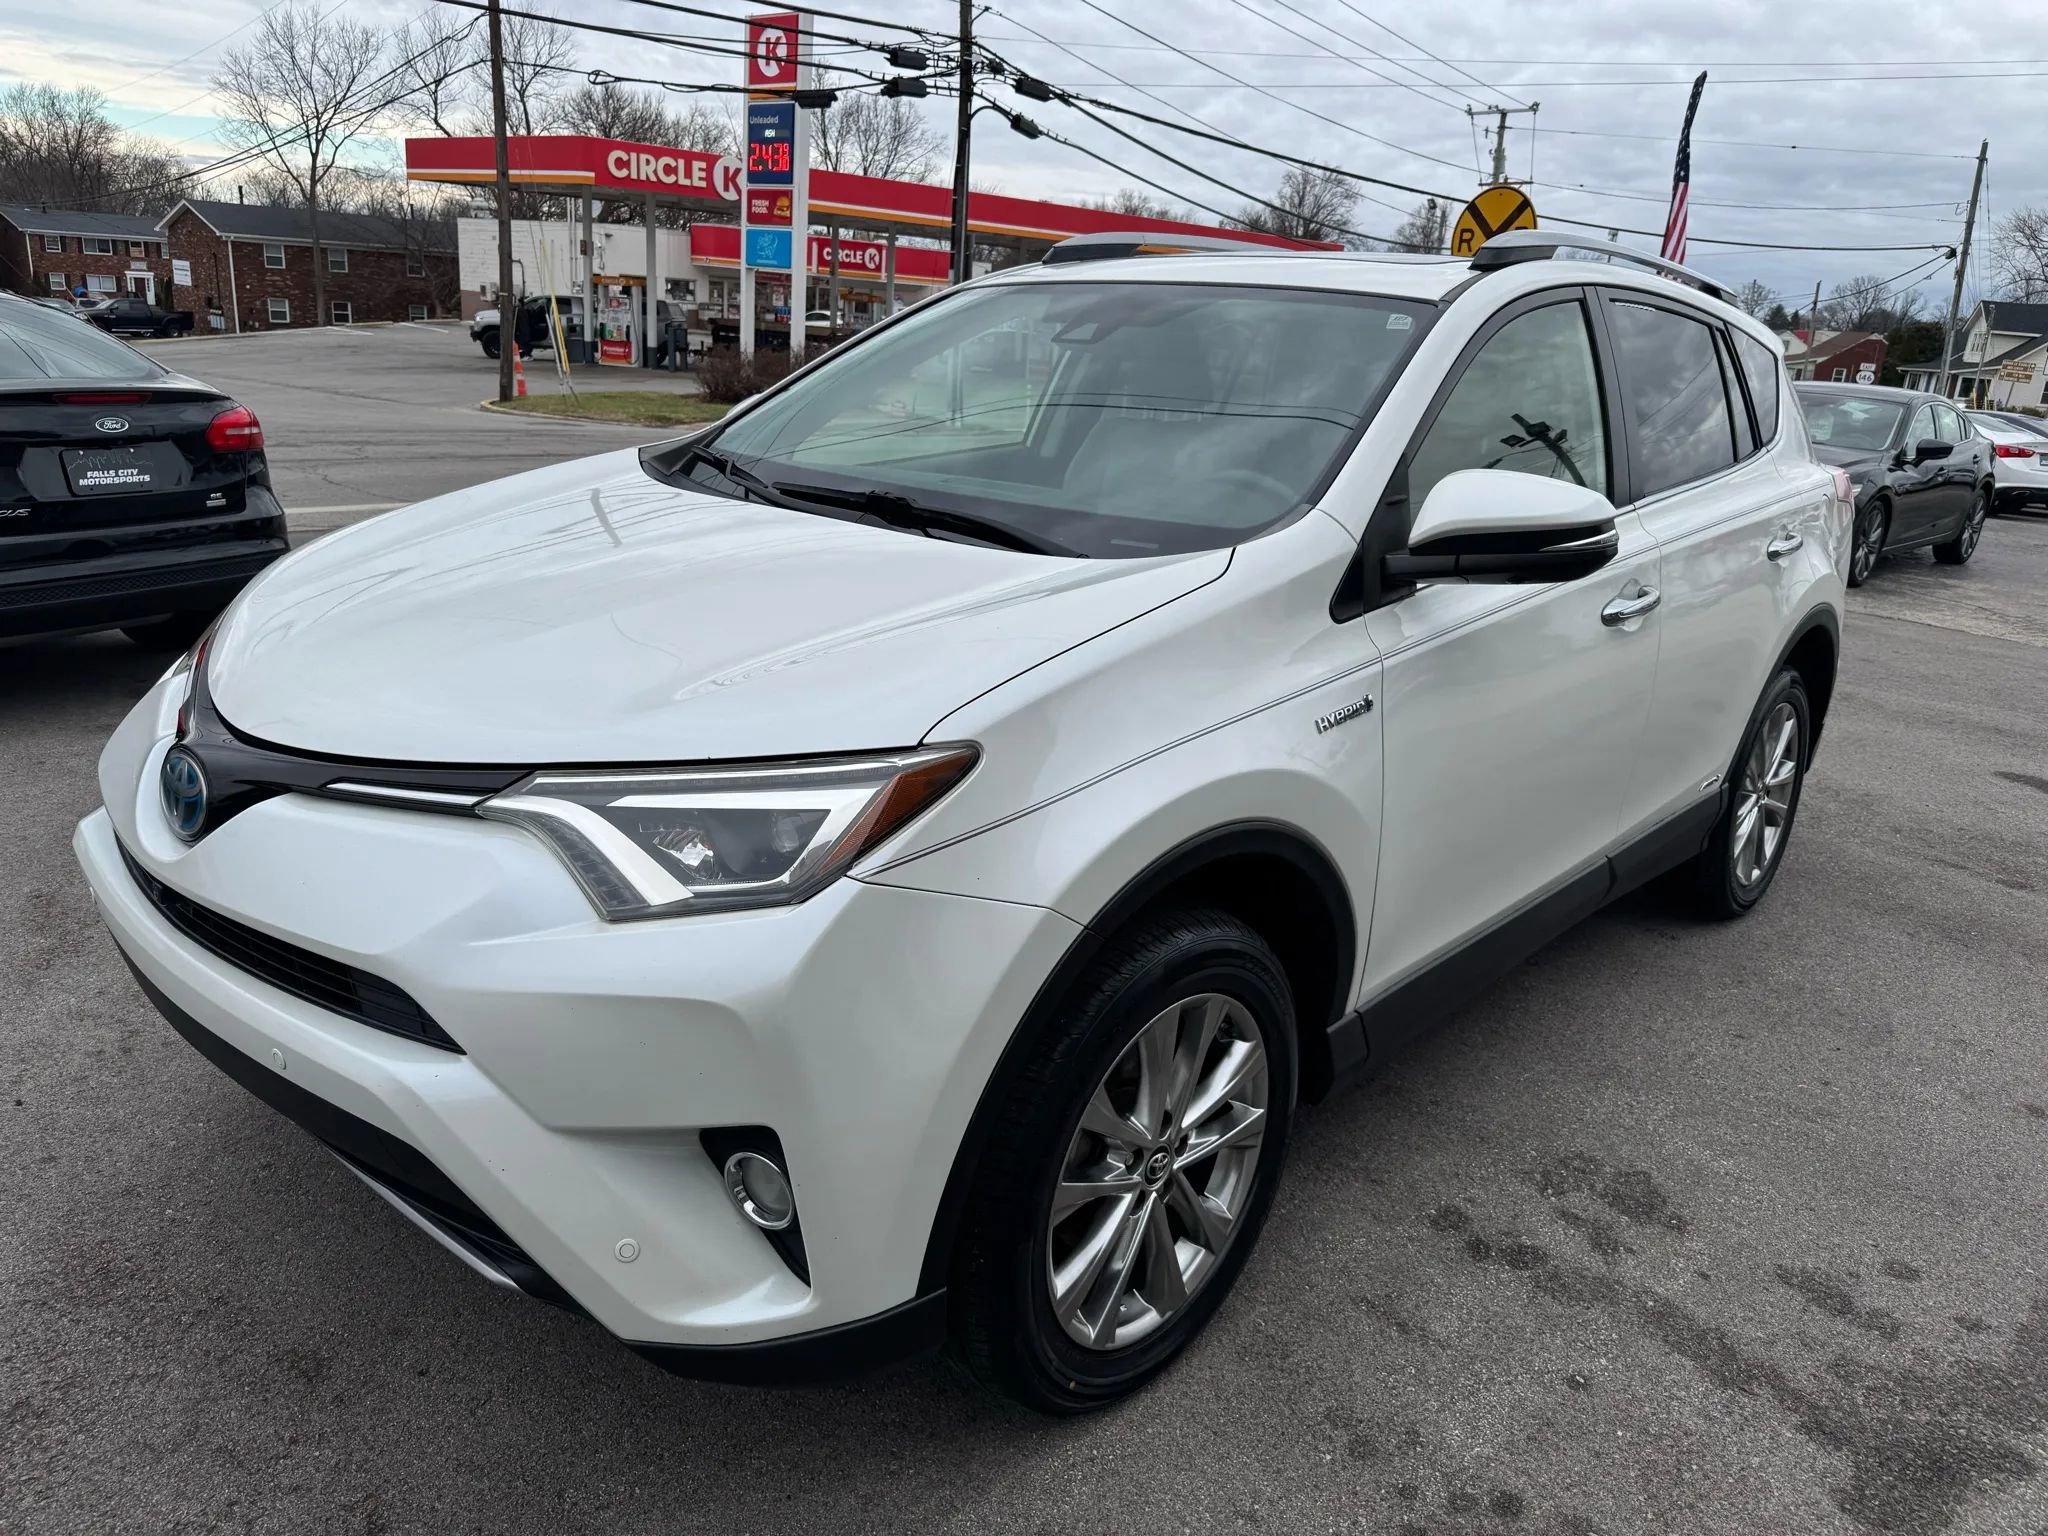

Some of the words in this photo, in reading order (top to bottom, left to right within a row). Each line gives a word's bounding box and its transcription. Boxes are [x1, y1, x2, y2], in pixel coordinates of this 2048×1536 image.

[749, 115, 779, 124] Unleaded
[607, 150, 707, 188] CIRCLE
[720, 163, 742, 199] K
[752, 199, 770, 207] FRESH
[1457, 228, 1475, 252] R
[823, 247, 863, 263] CRCLE
[1858, 373, 1872, 382] 146
[103, 420, 122, 429] Ford
[87, 470, 115, 478] FALLS
[118, 468, 138, 477] CITY
[79, 475, 150, 486] MOTORSPORTS
